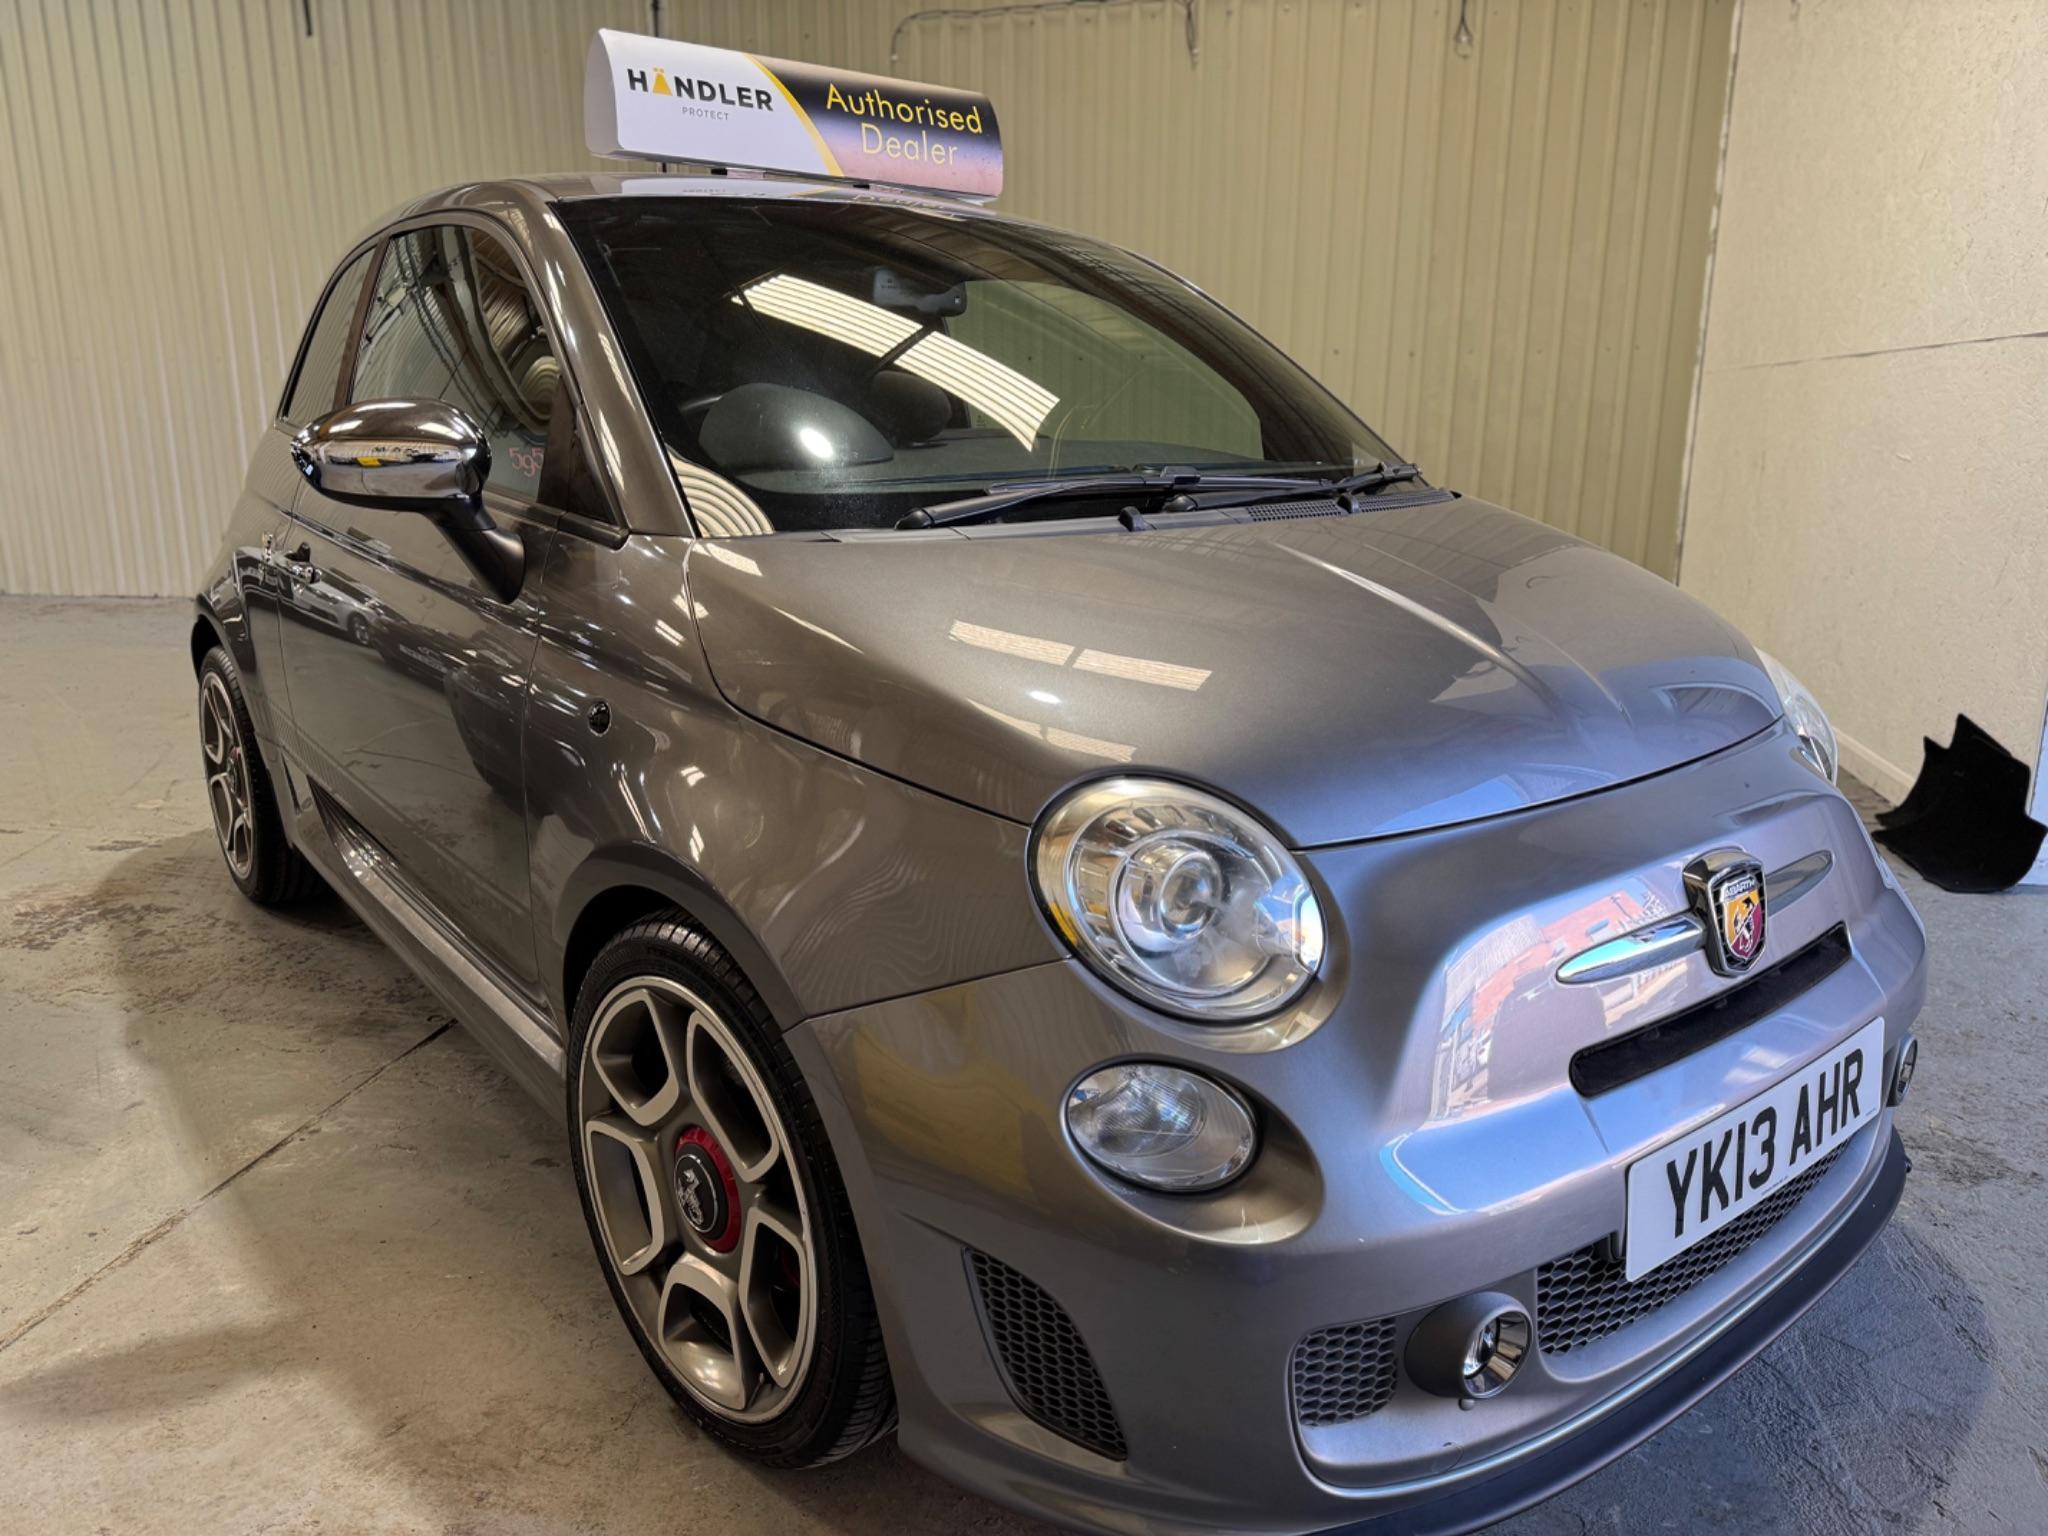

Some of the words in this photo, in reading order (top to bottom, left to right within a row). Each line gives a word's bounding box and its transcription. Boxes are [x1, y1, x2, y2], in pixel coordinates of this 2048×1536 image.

[682, 106, 729, 120] PROTECT
[826, 82, 983, 134] Authorised
[861, 122, 958, 165] Dealer
[1666, 1105, 1778, 1239] YK13
[1789, 1048, 1864, 1167] AHR
